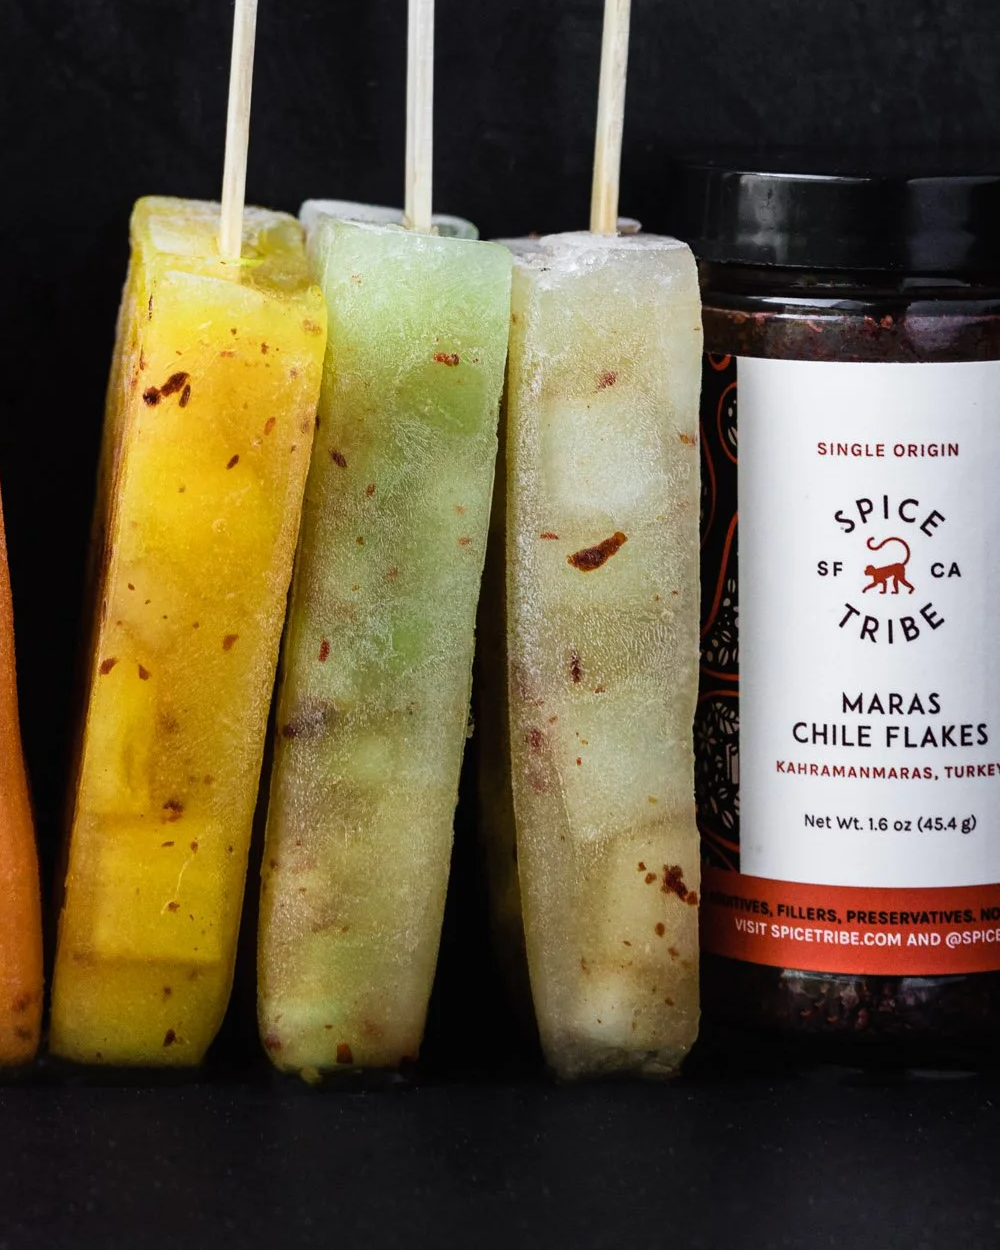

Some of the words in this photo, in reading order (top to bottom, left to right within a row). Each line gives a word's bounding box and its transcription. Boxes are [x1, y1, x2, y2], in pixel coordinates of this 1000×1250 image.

[818, 442, 885, 457] SINGLE
[894, 443, 959, 457] ORIGIN
[834, 495, 946, 537] SPICE
[817, 561, 843, 577] SF
[931, 562, 961, 578] CA
[839, 602, 945, 644] TRIBE
[843, 692, 941, 715] MARAS
[792, 722, 871, 747] CHILE
[886, 723, 989, 748] FLAKES
[776, 760, 939, 781] KAHRAMANMARAS,
[805, 814, 831, 829] Net
[836, 816, 863, 830] Wt.
[869, 818, 888, 831] 1.6
[894, 821, 912, 831] oz
[917, 816, 957, 833] (45.4
[961, 814, 976, 834] g)
[711, 891, 773, 917] ITIVES,
[777, 904, 841, 924] FILLERS,
[847, 910, 976, 925] PRESERVATIVES.
[735, 918, 767, 935] VISIT
[772, 925, 901, 946] SPICETRIBE.COM
[907, 933, 941, 946] AND
